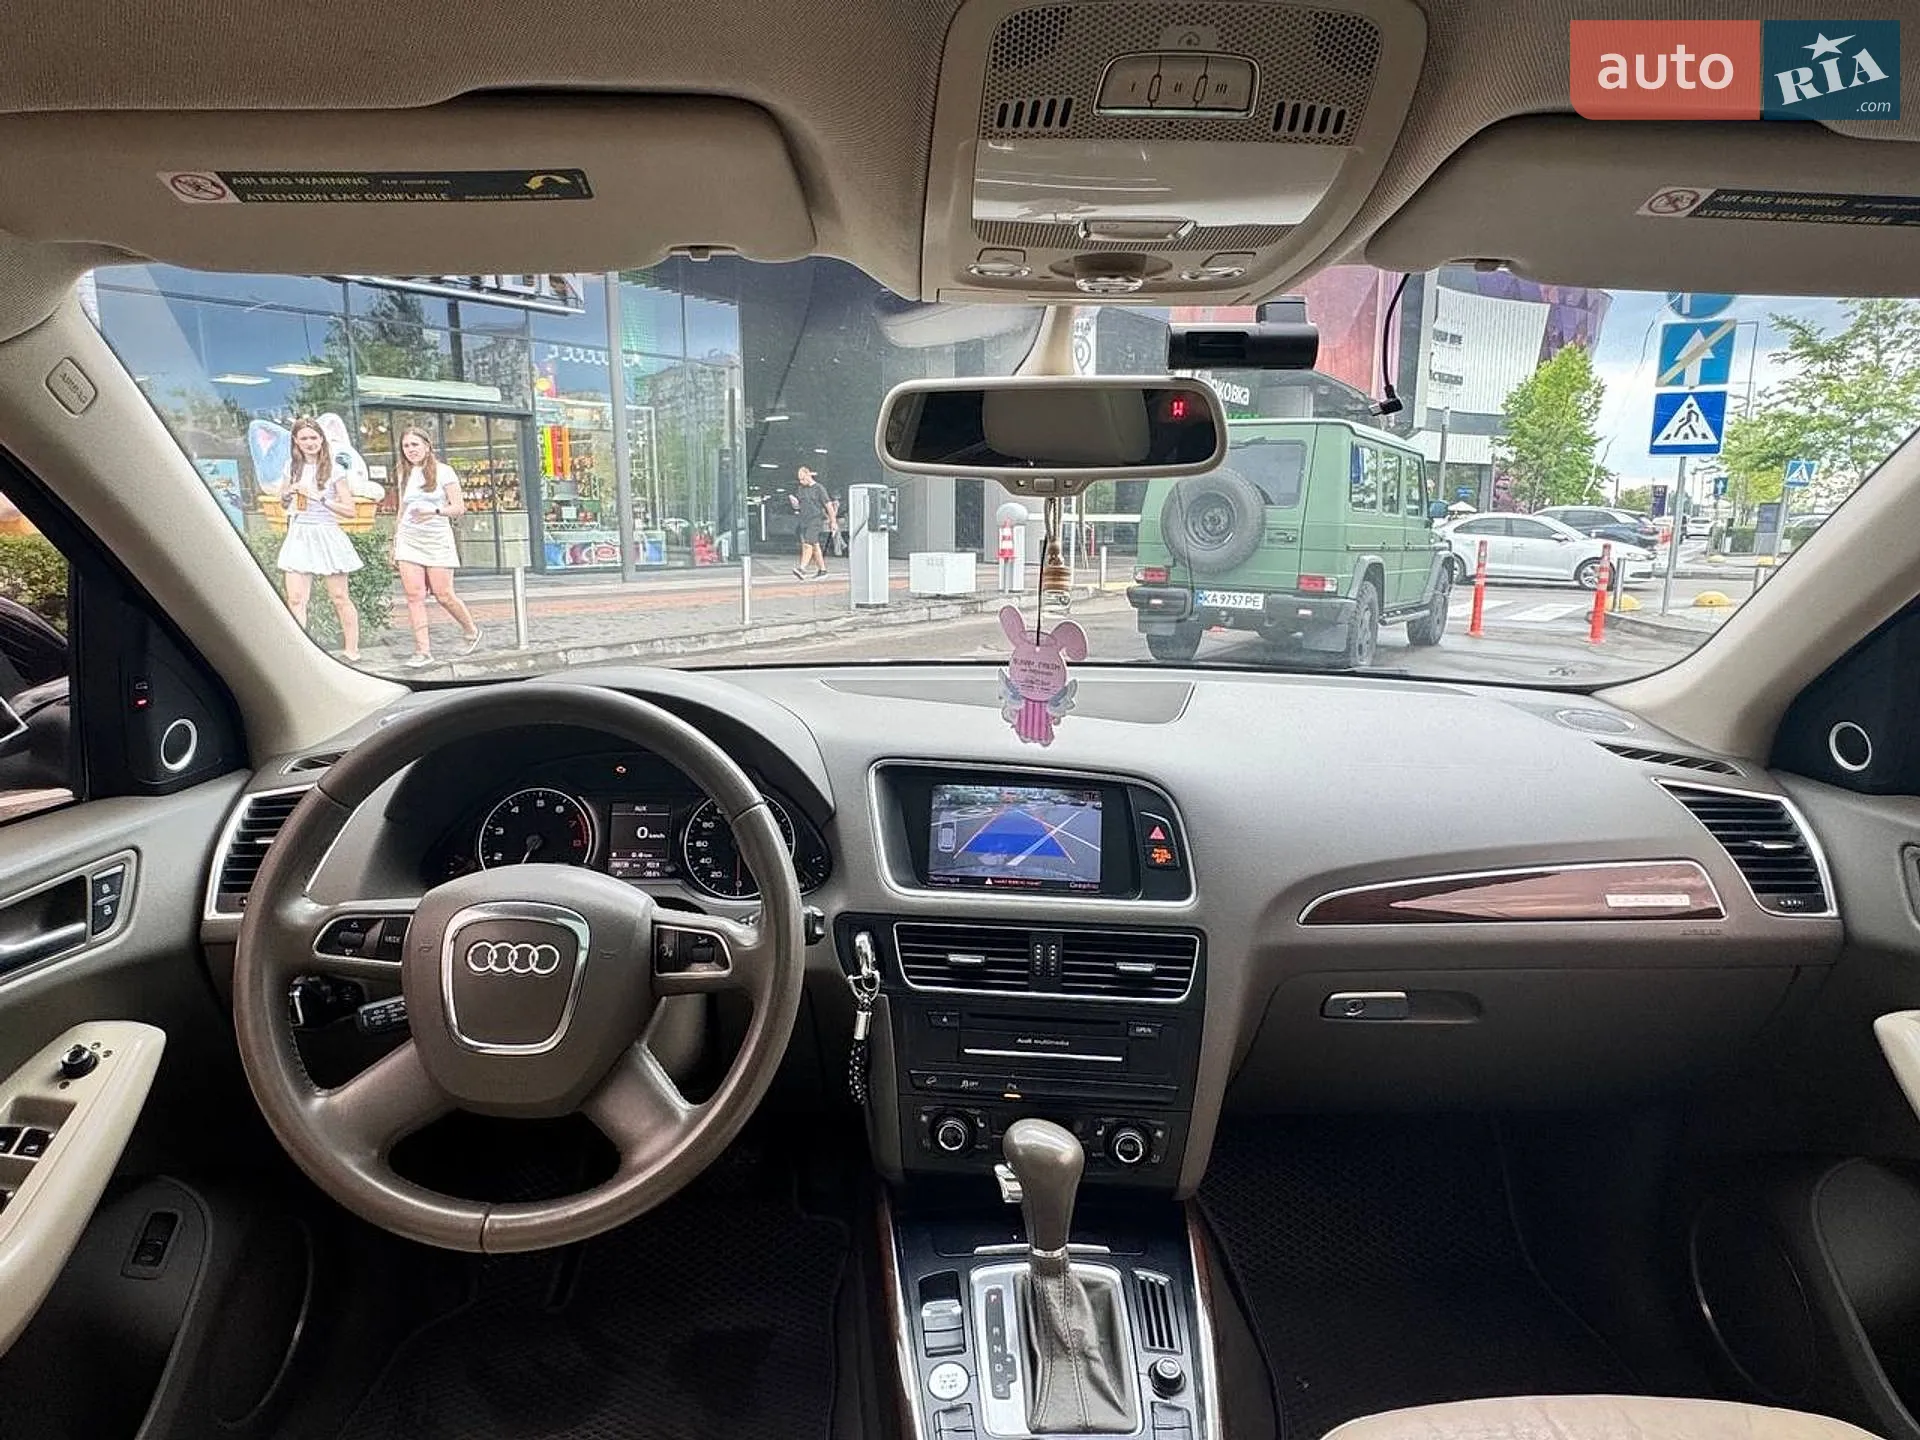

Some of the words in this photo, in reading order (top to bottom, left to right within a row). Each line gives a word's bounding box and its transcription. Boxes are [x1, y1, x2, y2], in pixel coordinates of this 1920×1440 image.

[232, 177, 257, 185] AIR
[260, 177, 292, 185] BAG
[295, 176, 370, 185] WARNING
[246, 192, 330, 201] ATTENTION
[334, 193, 362, 201] SAC
[636, 826, 649, 839] 0
[699, 857, 713, 865] 40
[993, 1344, 1002, 1354] N
